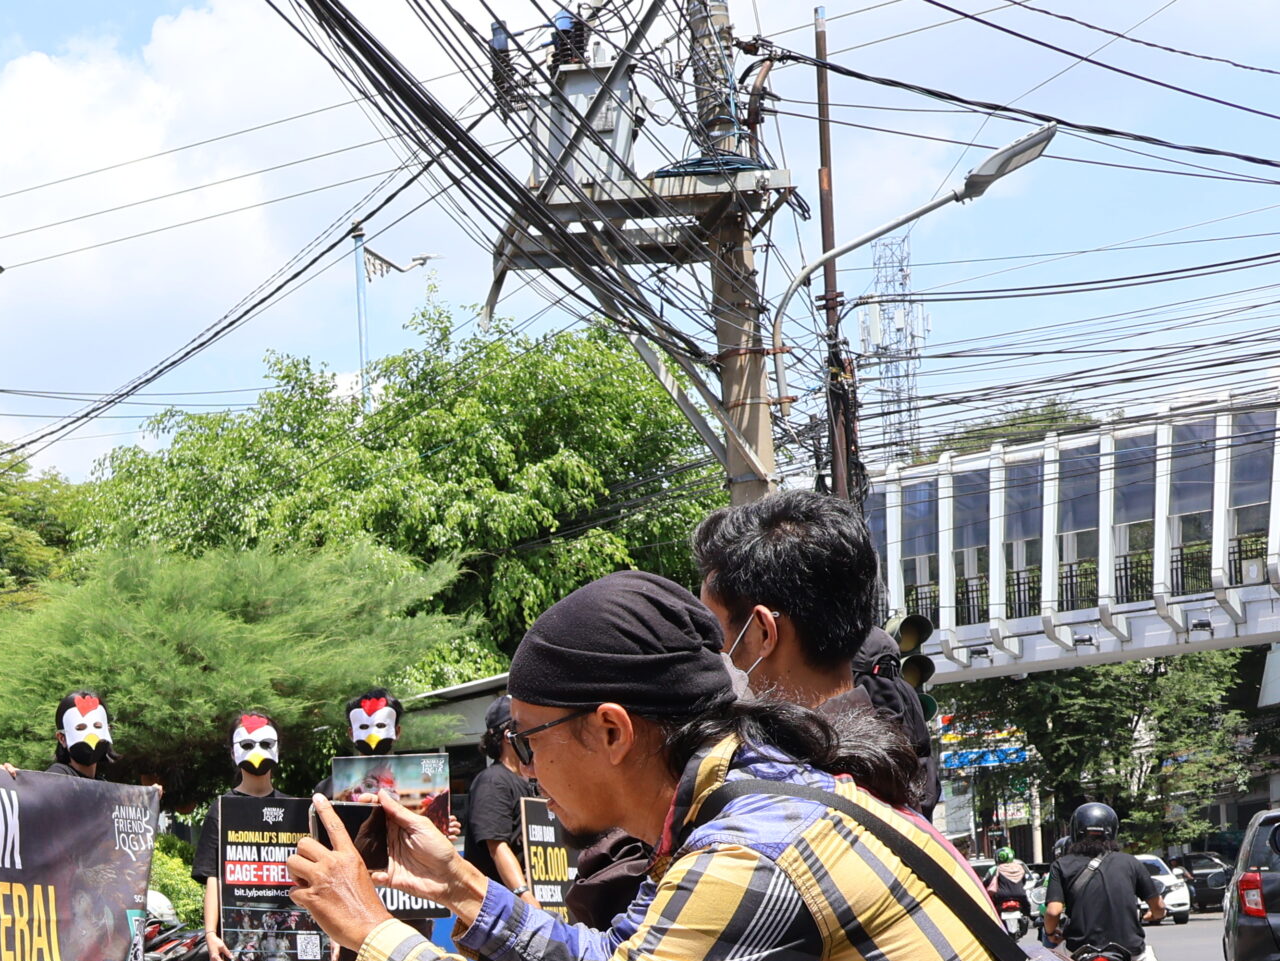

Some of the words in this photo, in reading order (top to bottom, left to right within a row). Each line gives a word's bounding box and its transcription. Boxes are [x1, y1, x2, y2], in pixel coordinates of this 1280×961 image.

[227, 830, 277, 844] McDONALD'S
[226, 845, 259, 862] MANA
[260, 846, 297, 862] KOMIT
[530, 846, 568, 881] 58.000
